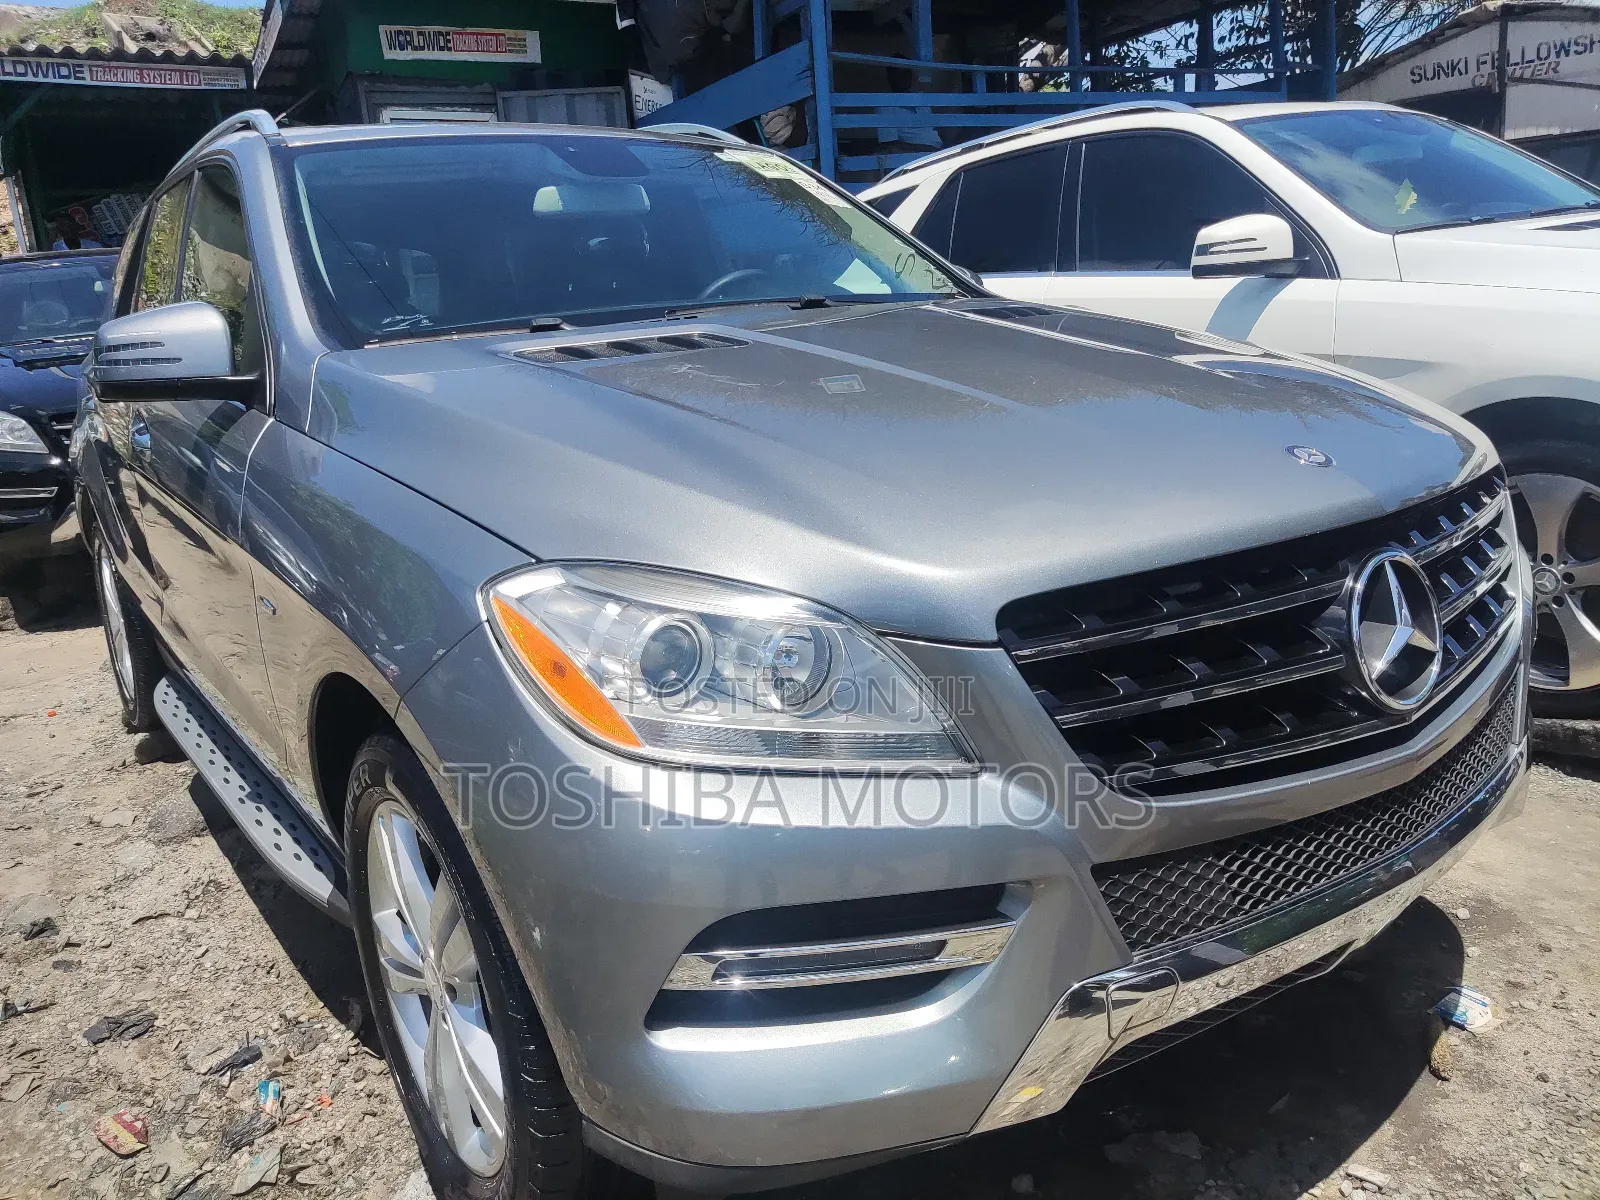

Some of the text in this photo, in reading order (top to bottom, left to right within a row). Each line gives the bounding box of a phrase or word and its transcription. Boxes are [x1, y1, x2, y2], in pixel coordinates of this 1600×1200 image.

[384, 29, 452, 52] WORLDWIDE
[91, 67, 140, 83] TRACKING
[143, 70, 180, 84] SYSTEM
[183, 73, 199, 85] LTD
[1409, 56, 1468, 84] SUNKI
